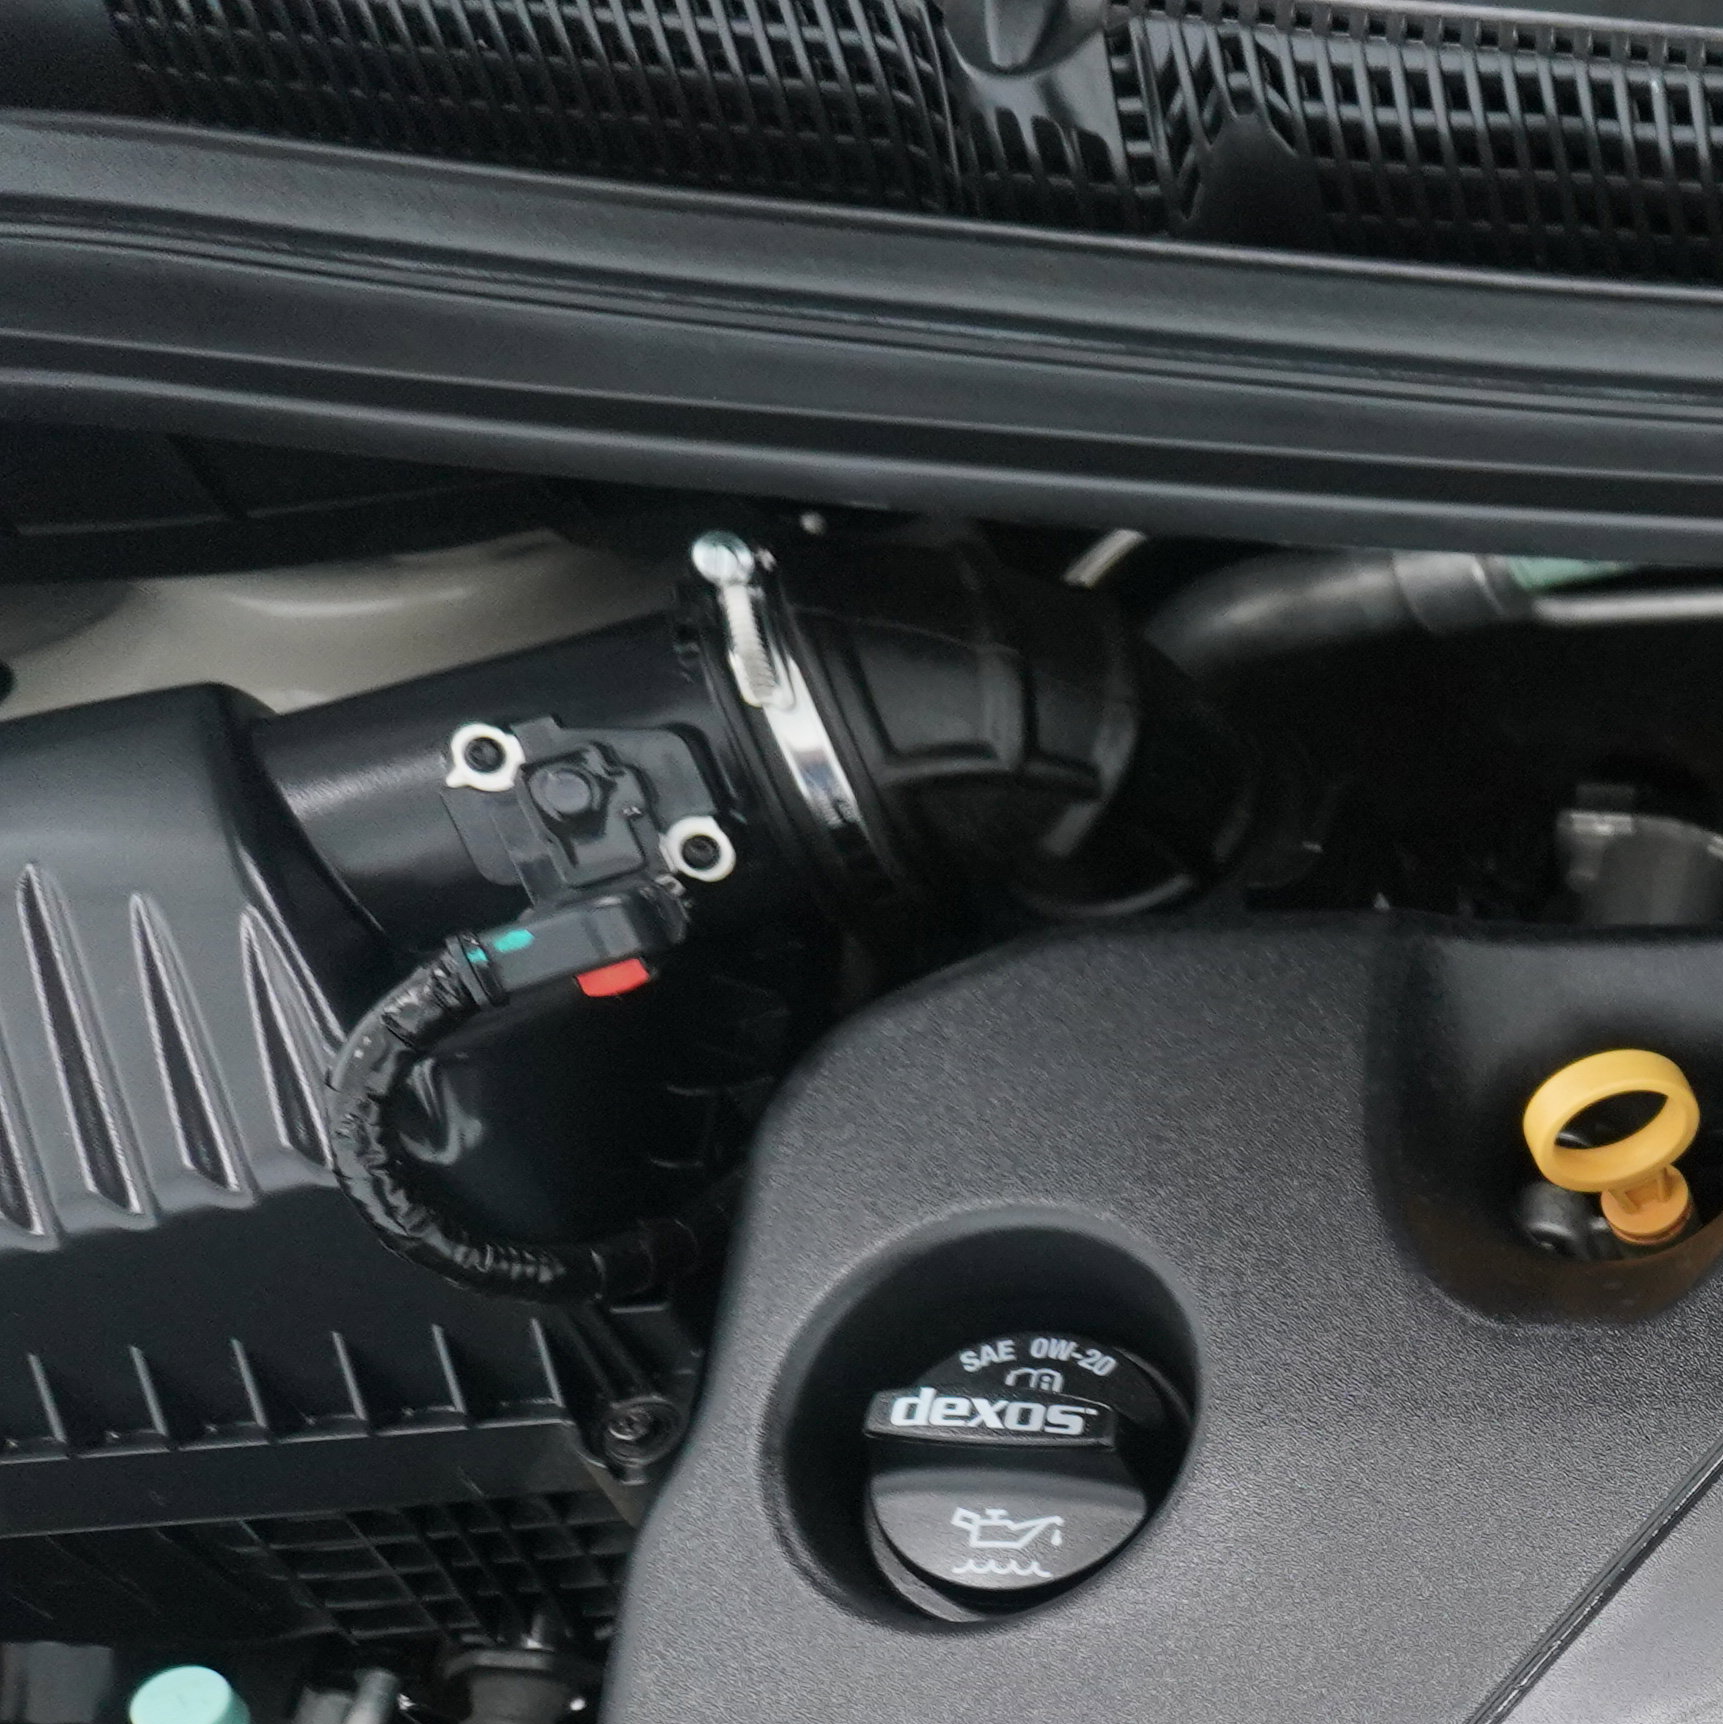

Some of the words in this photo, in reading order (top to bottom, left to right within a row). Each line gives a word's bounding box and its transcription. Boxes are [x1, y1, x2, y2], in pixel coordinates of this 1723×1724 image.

[959, 1338, 1016, 1373] SAE
[1030, 1337, 1118, 1377] 0W-20
[890, 1387, 1086, 1436] dexos
